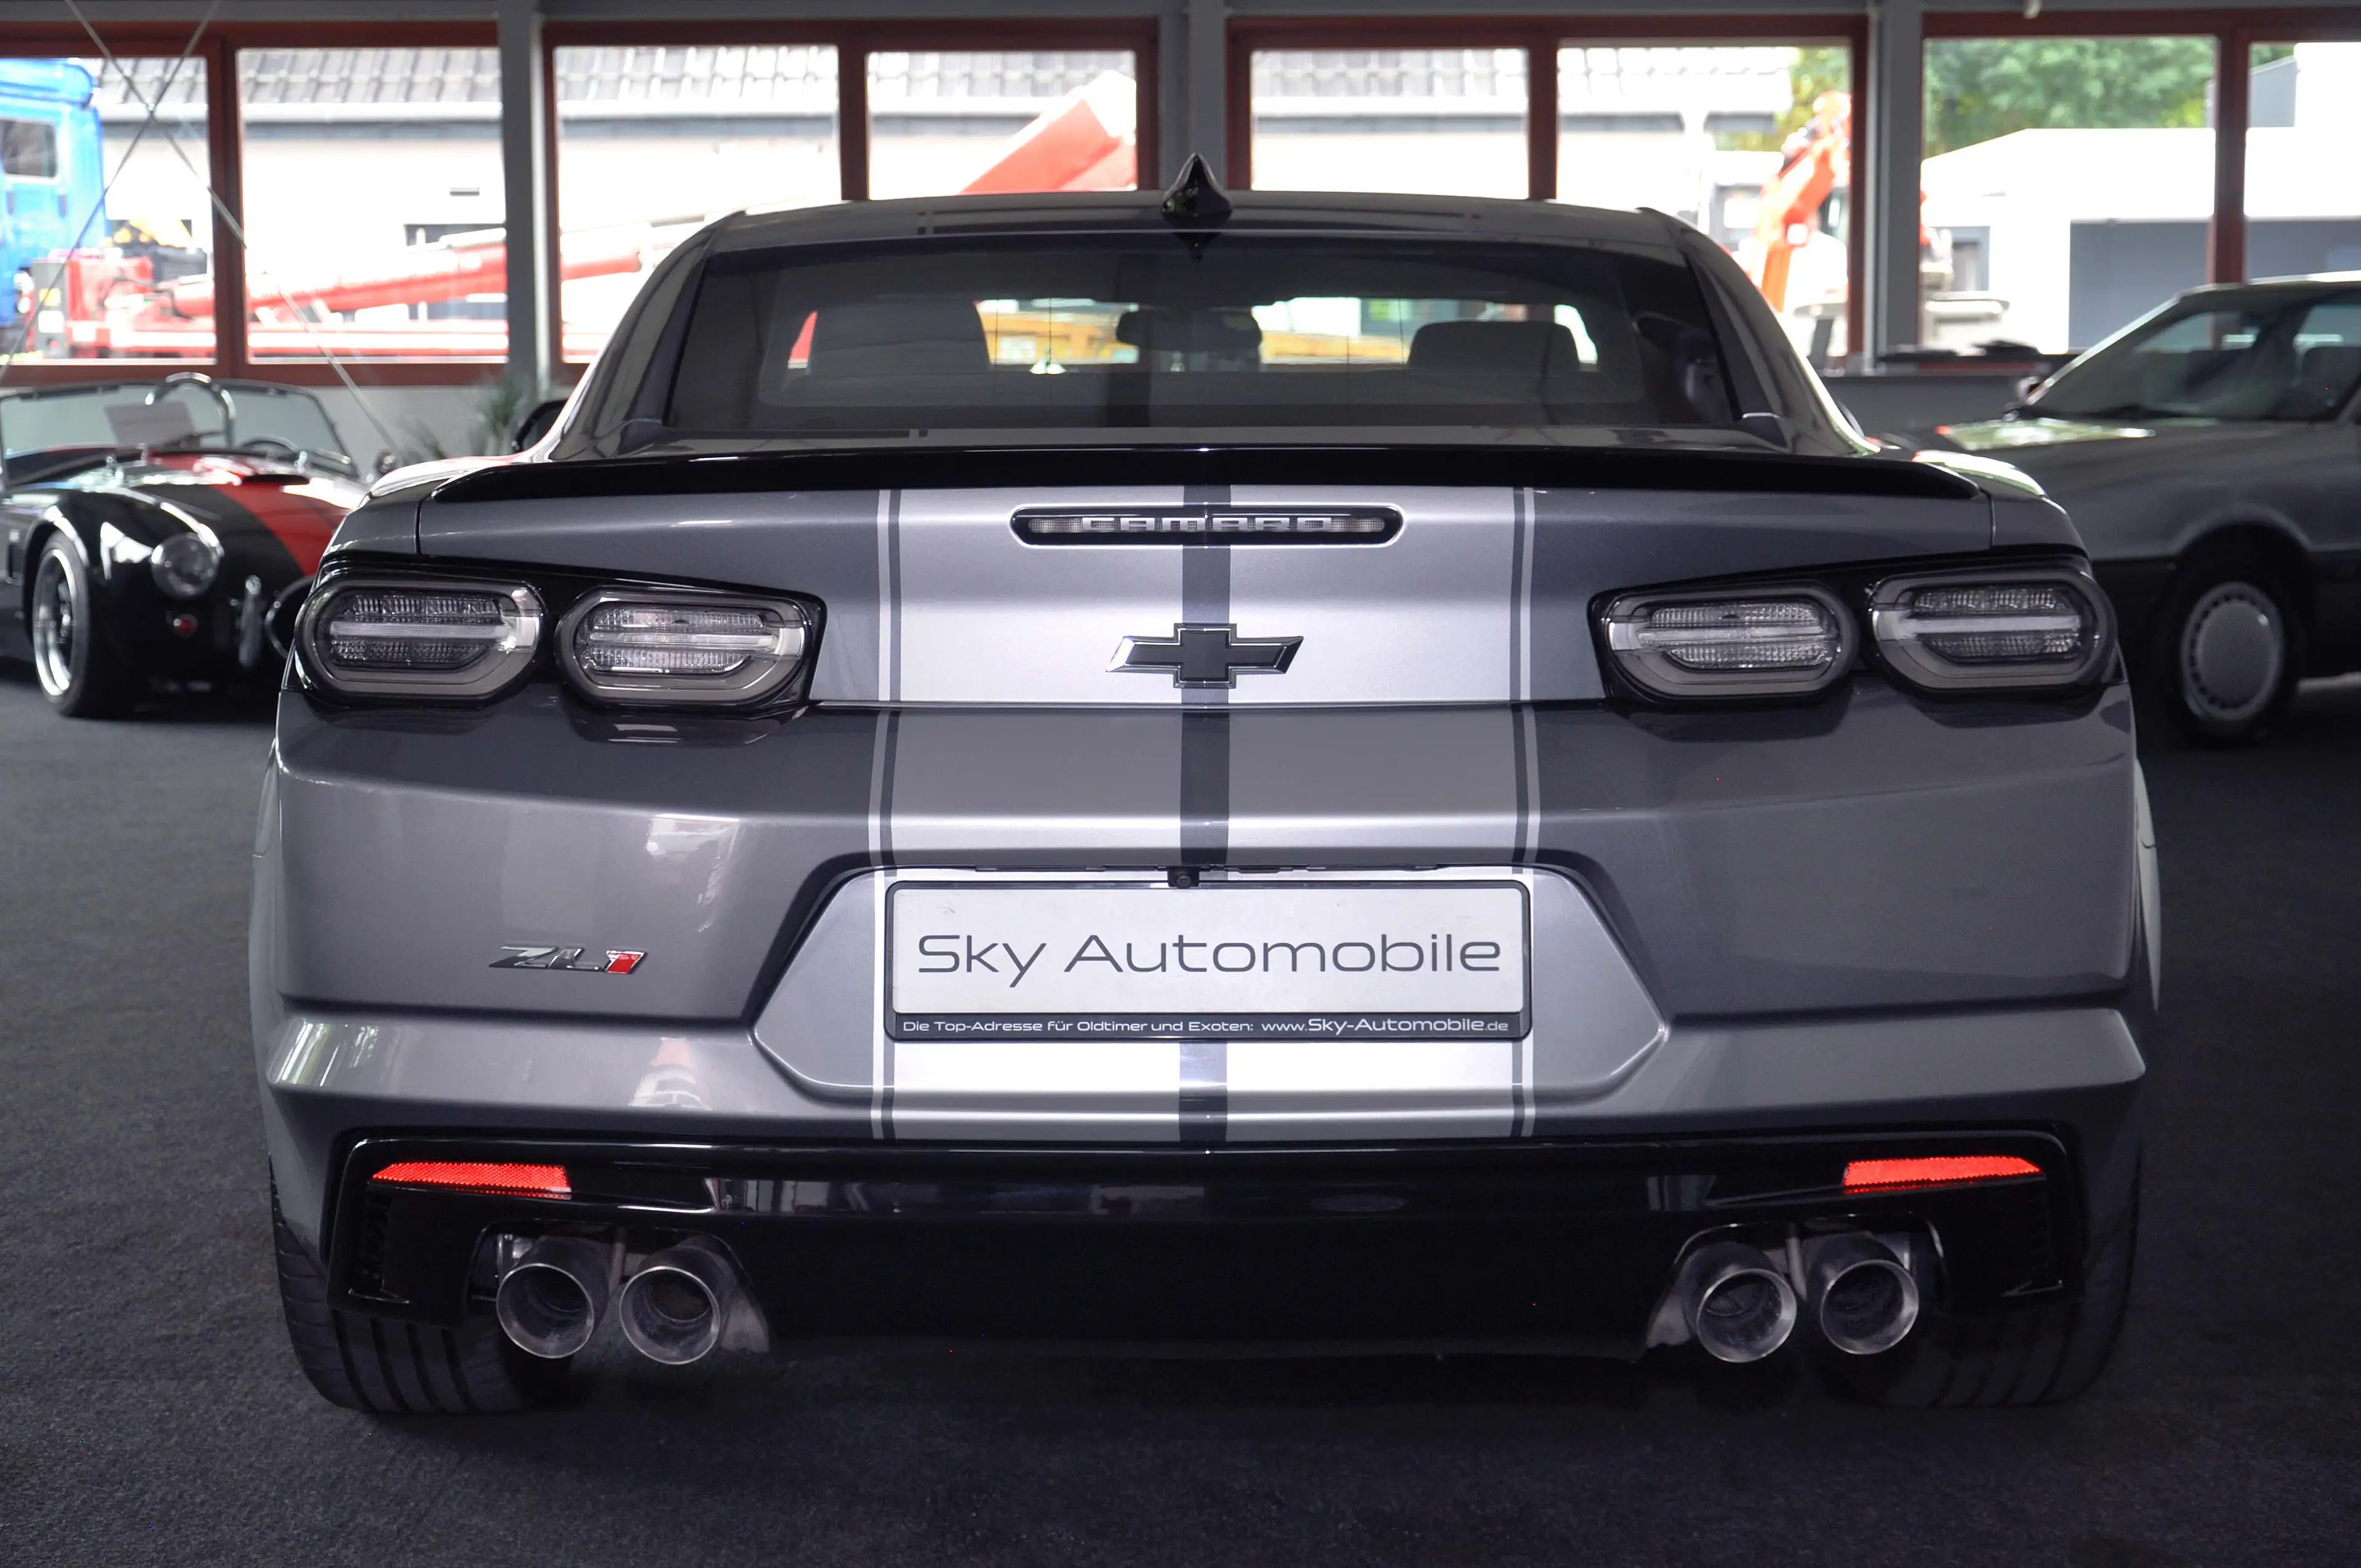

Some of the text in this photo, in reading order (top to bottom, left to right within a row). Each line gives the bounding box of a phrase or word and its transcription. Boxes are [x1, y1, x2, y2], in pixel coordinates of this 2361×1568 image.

[1082, 517, 1332, 531] CAMARO
[919, 933, 1500, 988] Sky Automobile
[903, 1018, 1509, 1035] Die Top-Adresse für Oldtimer und Exoten: www.Sky-Automobile.de
